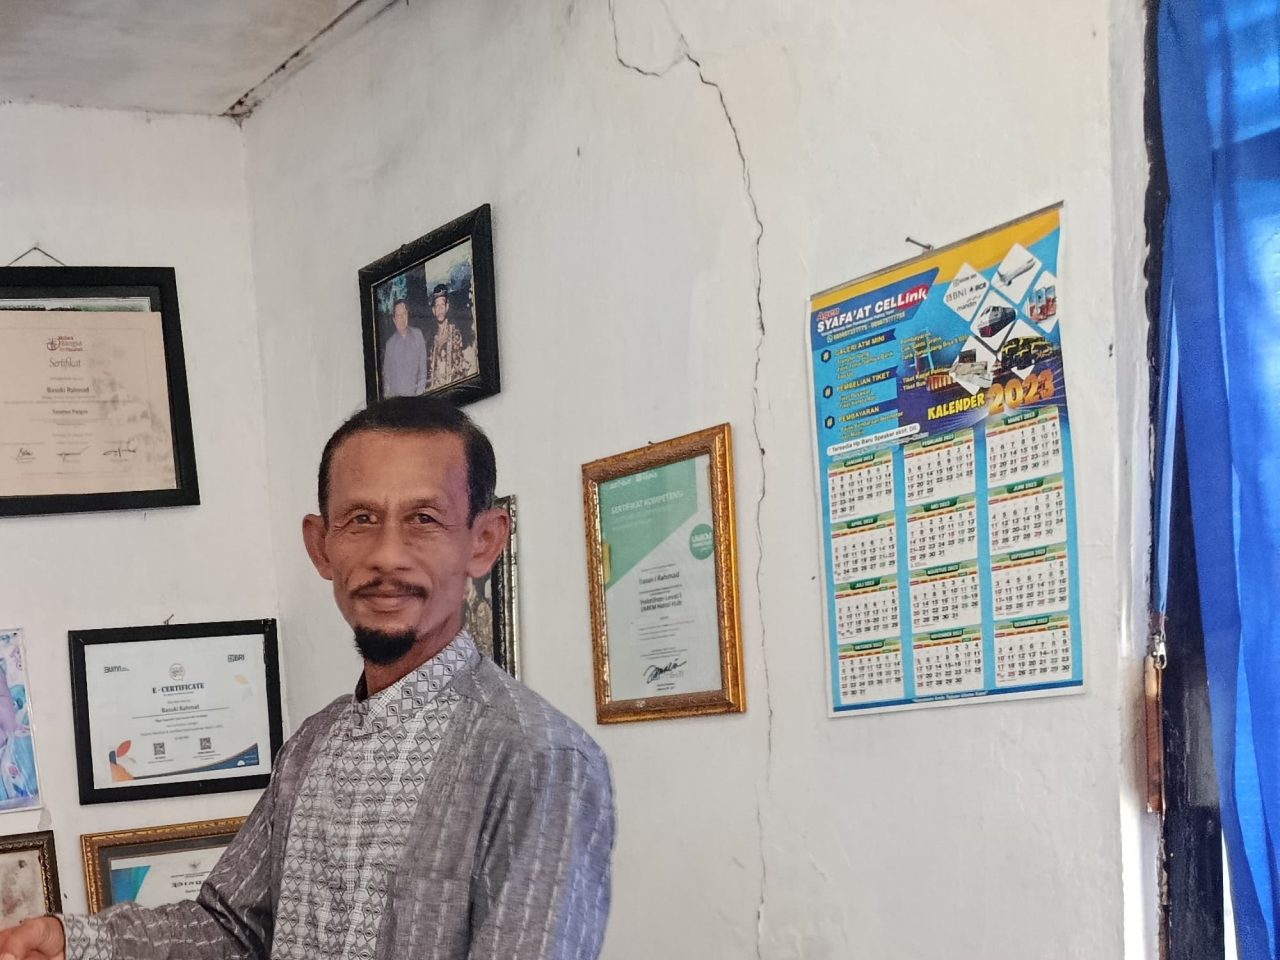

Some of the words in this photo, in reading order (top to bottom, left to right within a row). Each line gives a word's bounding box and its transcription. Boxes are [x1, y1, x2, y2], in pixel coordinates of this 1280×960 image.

[816, 305, 872, 333] SYAFA'AT
[874, 287, 928, 314] CELLink
[928, 392, 986, 420] KALENDER
[988, 368, 1056, 416] 2023
